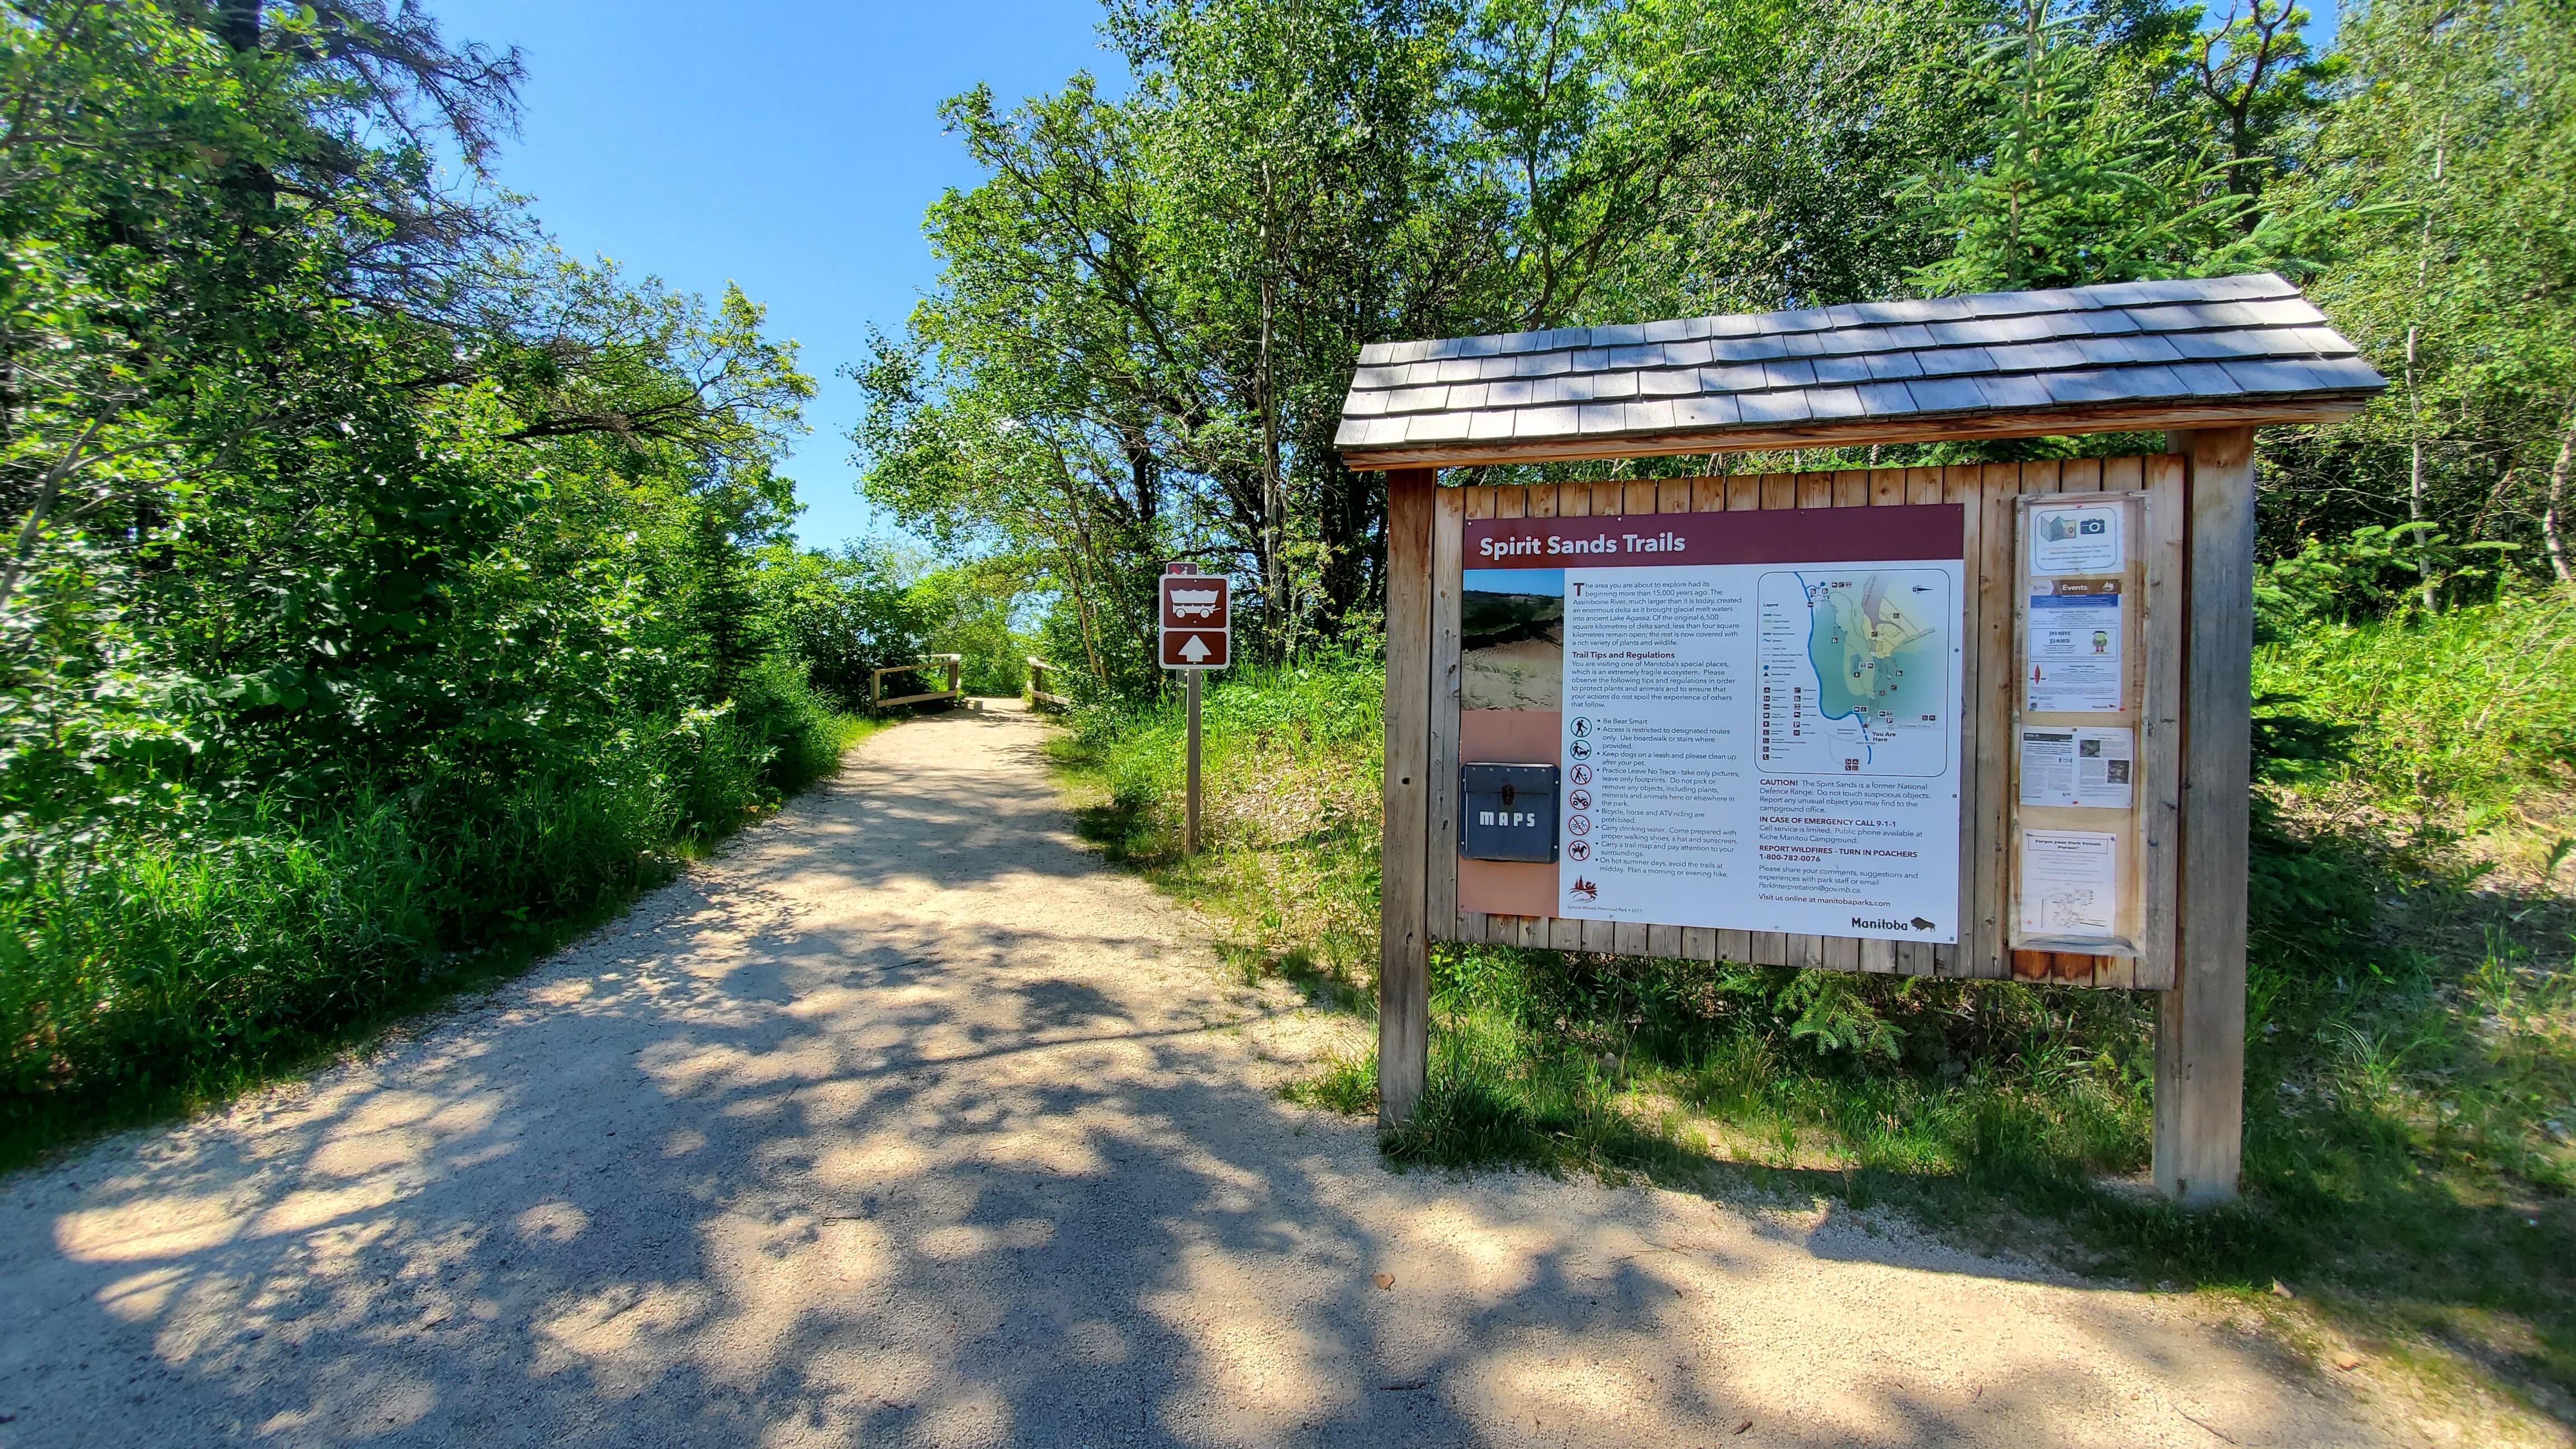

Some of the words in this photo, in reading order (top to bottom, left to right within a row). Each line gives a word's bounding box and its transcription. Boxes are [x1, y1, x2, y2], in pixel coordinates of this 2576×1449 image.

[1480, 536, 1541, 560] Spirit
[1546, 534, 1617, 555] Sands
[1622, 532, 1685, 552] Trails
[1662, 581, 1687, 589] explore
[1585, 590, 1617, 598] beginning
[1647, 598, 1666, 606] larger
[1695, 597, 1716, 605] today,
[1590, 651, 1607, 660] Tips
[1680, 661, 1704, 669] special
[1705, 661, 1729, 669] places,
[1671, 727, 1708, 735] designated
[1602, 750, 1619, 759] Keep
[1620, 751, 1637, 759] dogs
[1790, 788, 1813, 797] Range.
[1902, 792, 1931, 800] objects.
[1760, 796, 1783, 804] Report
[1826, 798, 1848, 806] object
[1602, 808, 1625, 816] Bicycle,
[1673, 810, 1693, 819] riding
[1480, 811, 1535, 827] MAPS
[1857, 828, 1881, 836] phone
[1809, 835, 1858, 844] Campground.
[1759, 853, 1821, 862] 1-800-782-0076
[1873, 849, 1918, 858] POACHERS
[1817, 897, 1891, 907] manitobaparks.com
[1852, 917, 1908, 931] Manitoba
